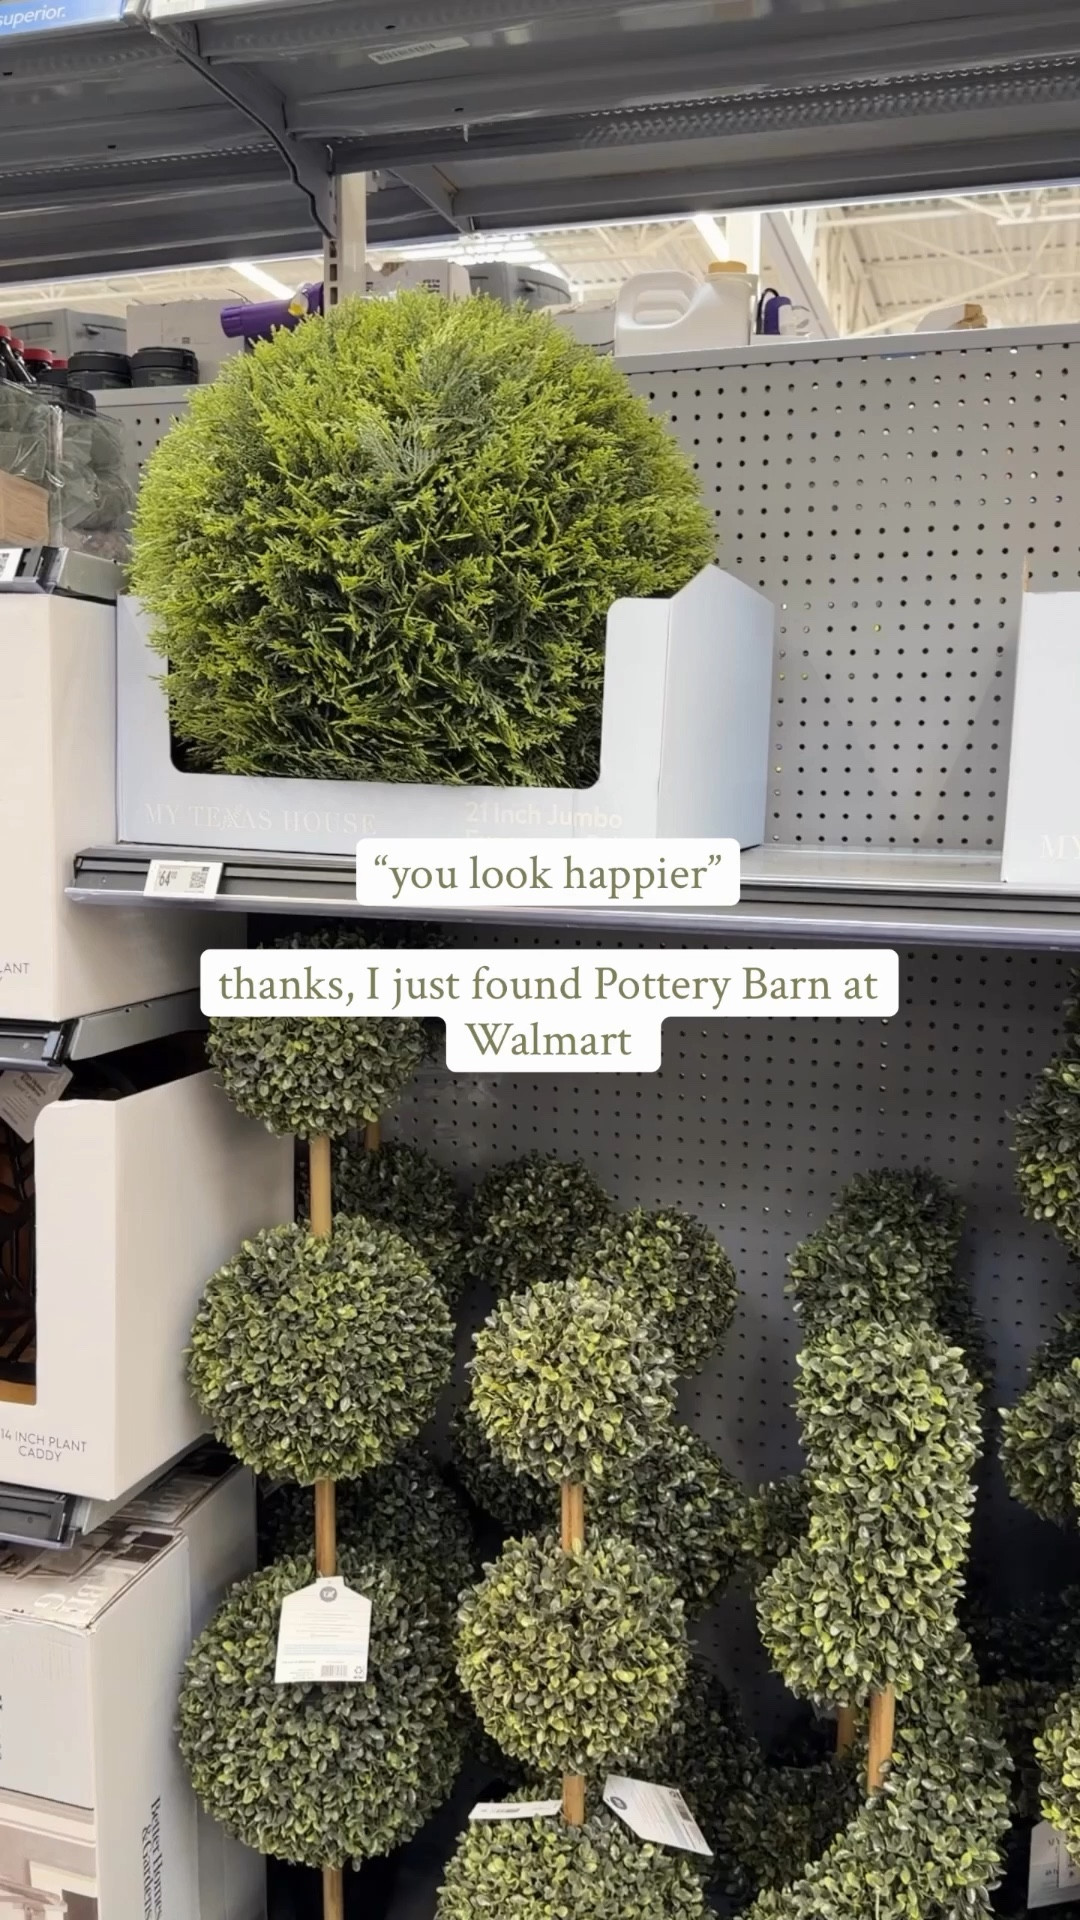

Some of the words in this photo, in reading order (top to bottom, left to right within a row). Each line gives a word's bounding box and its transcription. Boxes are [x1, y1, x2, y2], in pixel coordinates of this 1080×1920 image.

[145, 803, 184, 825] MY
[189, 804, 272, 832] TEXAS
[282, 809, 377, 836] HOUSE
[465, 801, 488, 823] 21
[494, 803, 541, 825] Inch
[547, 804, 623, 830] Jumbo
[1, 1428, 11, 1440] 14
[15, 1431, 44, 1445] INCH
[49, 1436, 87, 1452] PLANT
[18, 1445, 62, 1462] CADDY
